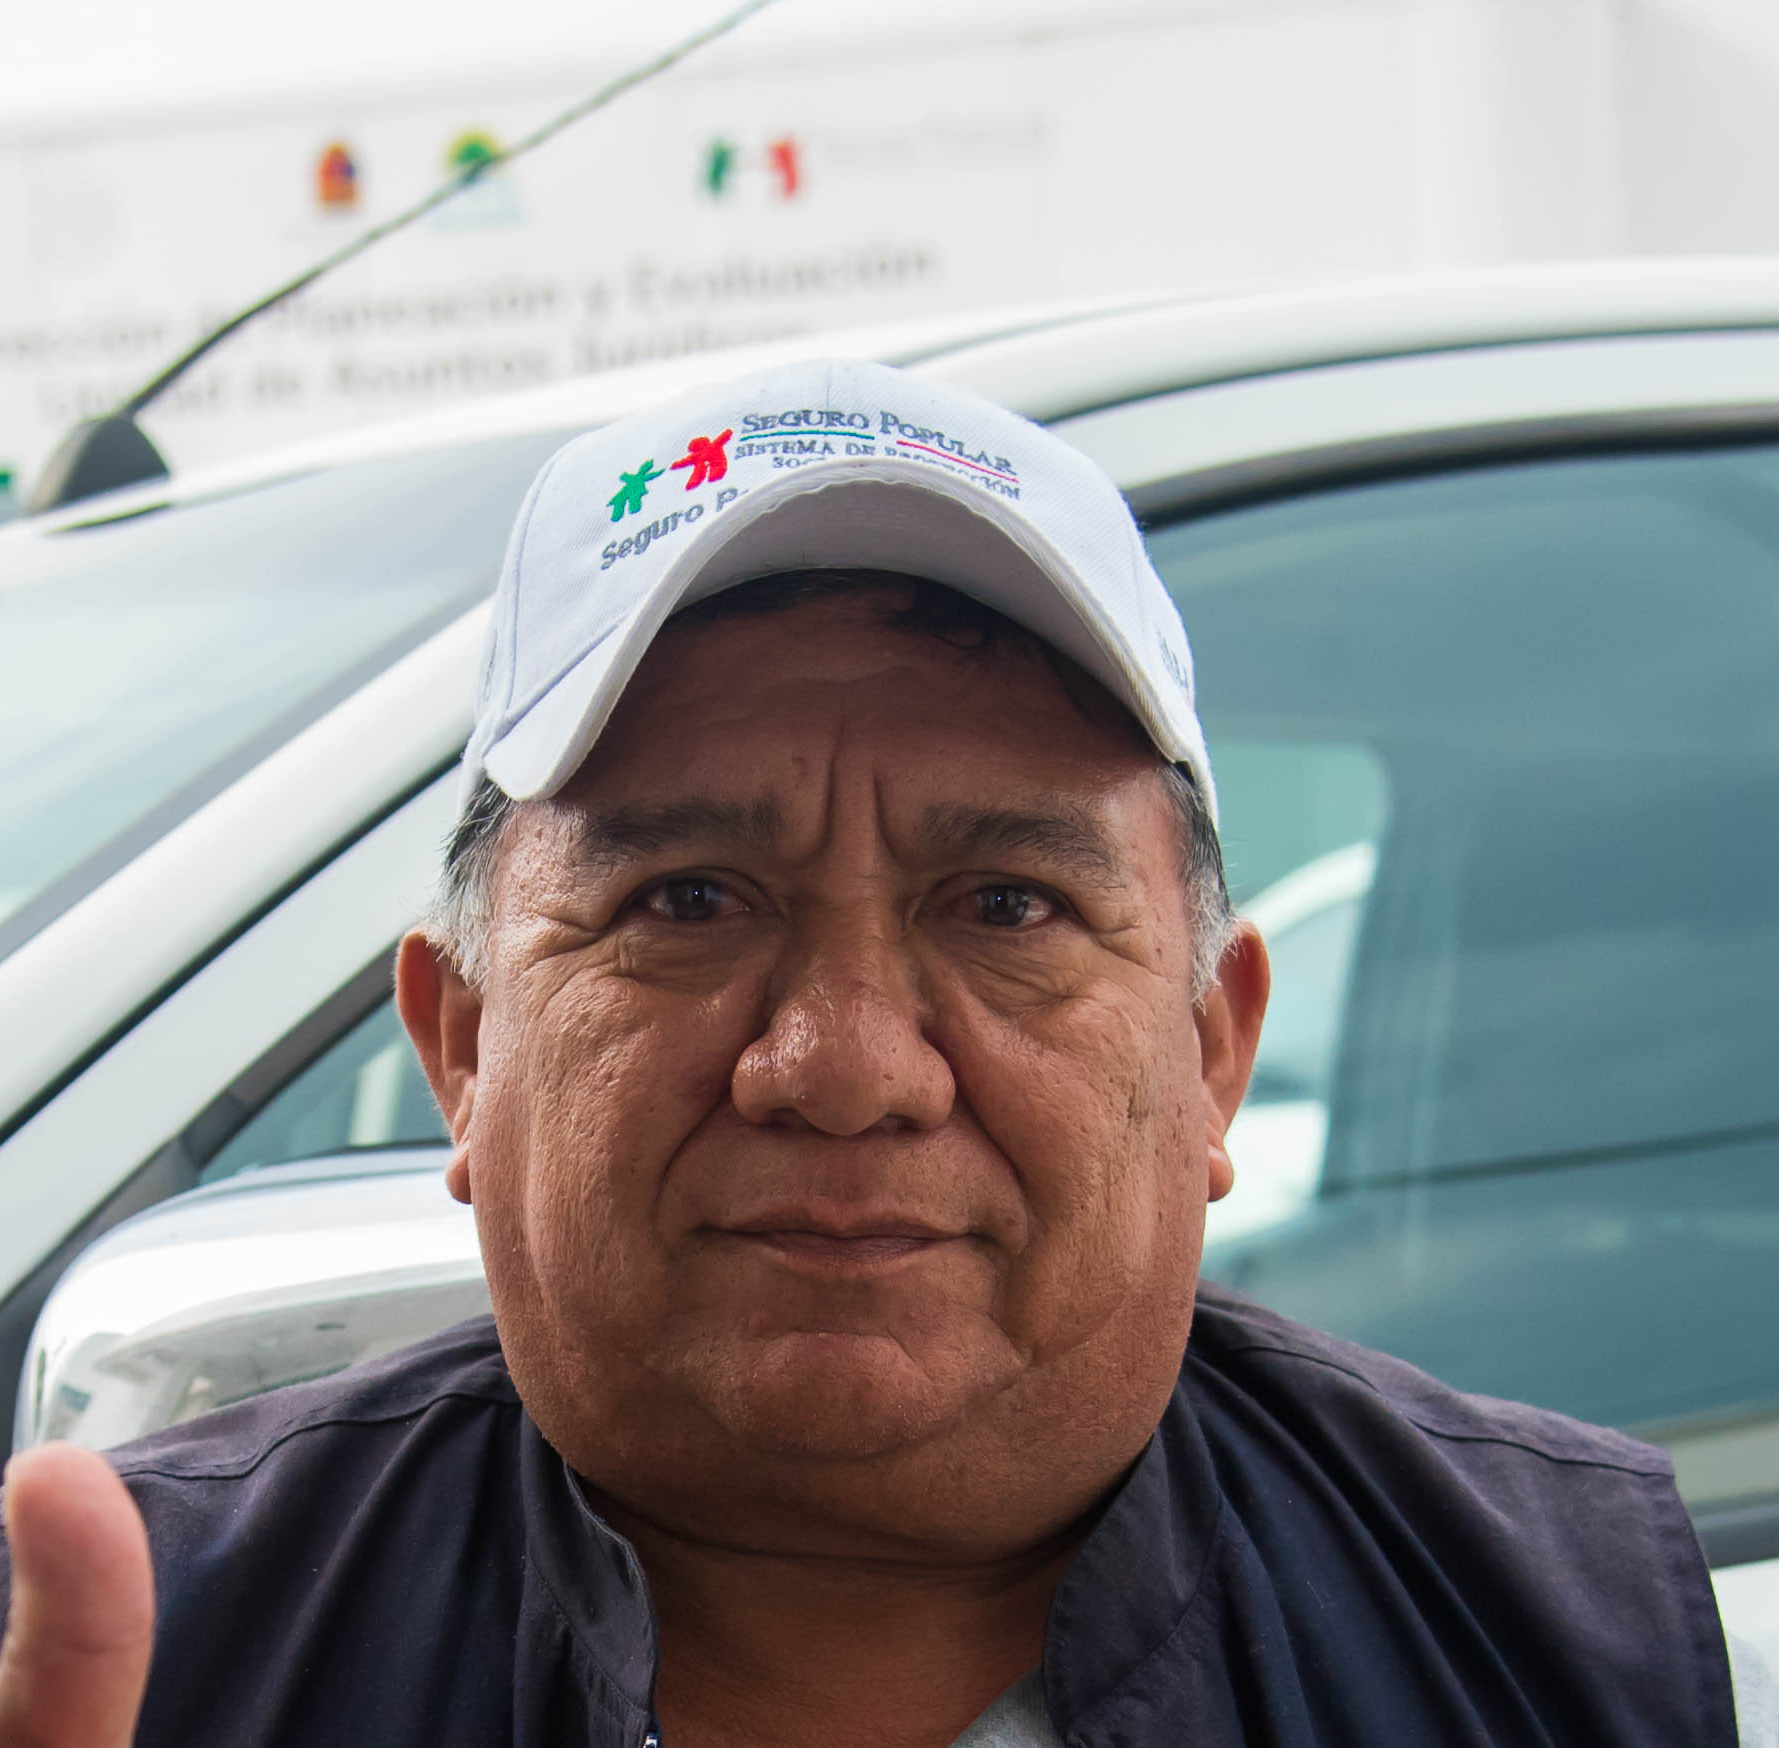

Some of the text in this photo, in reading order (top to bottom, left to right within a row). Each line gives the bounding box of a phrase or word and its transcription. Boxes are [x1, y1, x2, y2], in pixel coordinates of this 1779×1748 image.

[734, 440, 836, 461] SISTEMA
[741, 409, 1018, 476] SEGURO POPULAR
[601, 504, 705, 570] Seguro
